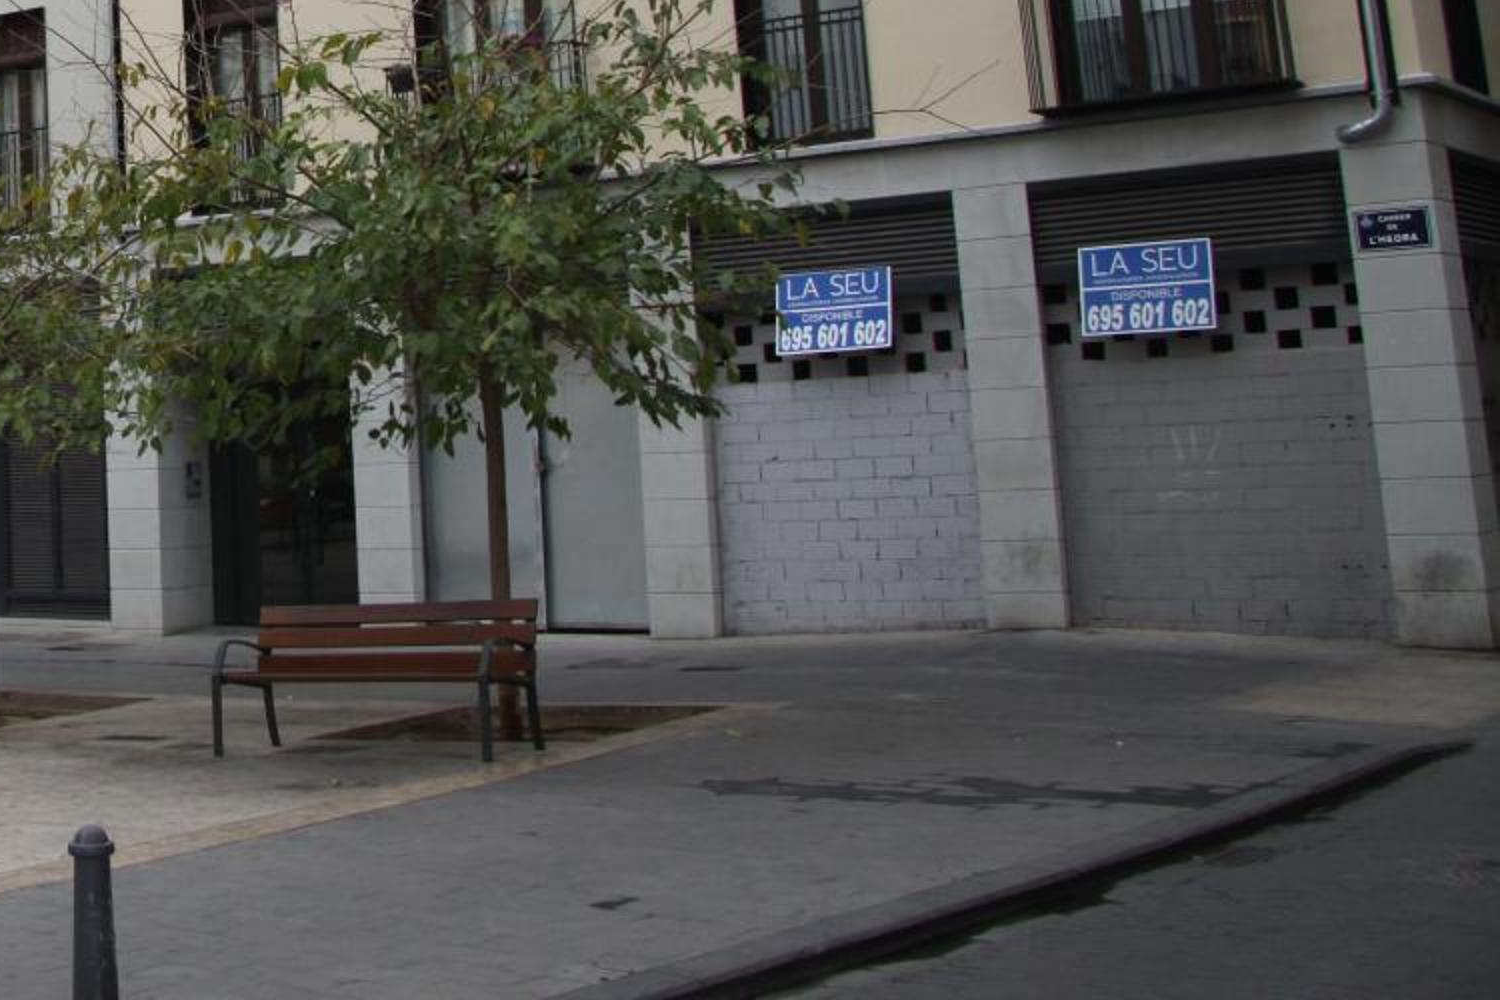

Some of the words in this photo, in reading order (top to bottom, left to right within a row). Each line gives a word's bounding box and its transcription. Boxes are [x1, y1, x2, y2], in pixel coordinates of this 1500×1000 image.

[1091, 250, 1131, 277] LA
[1141, 244, 1199, 273] SEU
[786, 277, 820, 301] LA
[829, 269, 880, 297] SEU
[1110, 287, 1182, 302] DISPONIBLE
[801, 310, 864, 323] DISPONIBLE
[1088, 303, 1124, 331] 695
[1129, 300, 1165, 329] 601
[1171, 297, 1210, 327] 602
[781, 325, 813, 351] 695
[817, 322, 850, 348] 601
[853, 319, 887, 345] 602
